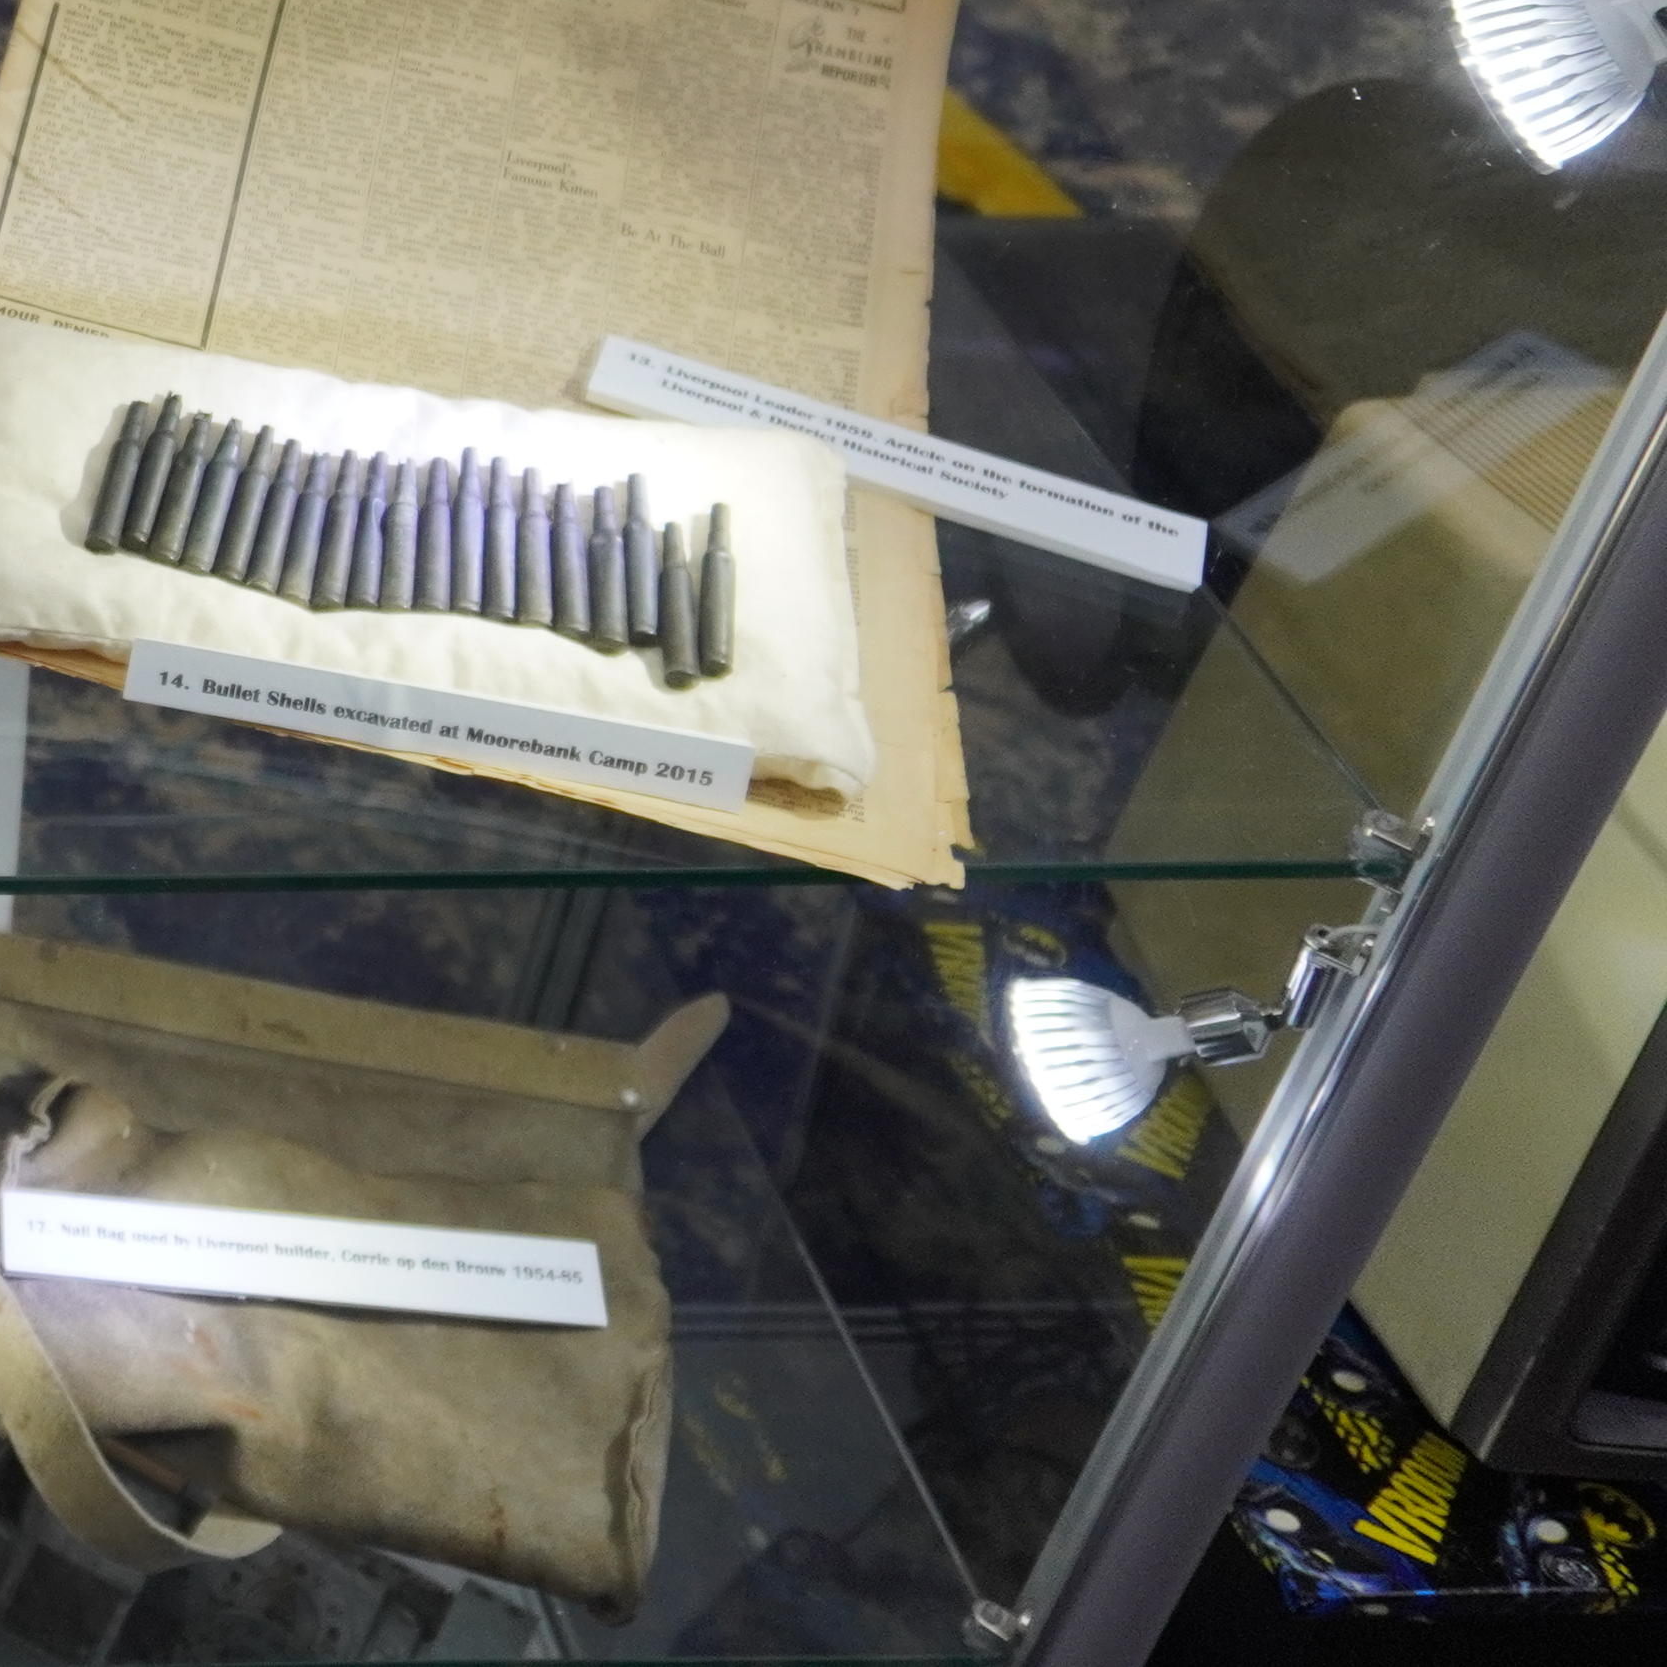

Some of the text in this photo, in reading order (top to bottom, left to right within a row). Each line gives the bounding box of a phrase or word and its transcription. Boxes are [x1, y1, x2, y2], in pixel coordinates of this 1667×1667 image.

[159, 671, 713, 786] 14. Bullet Shells excavated at Moorebank Camp 2015
